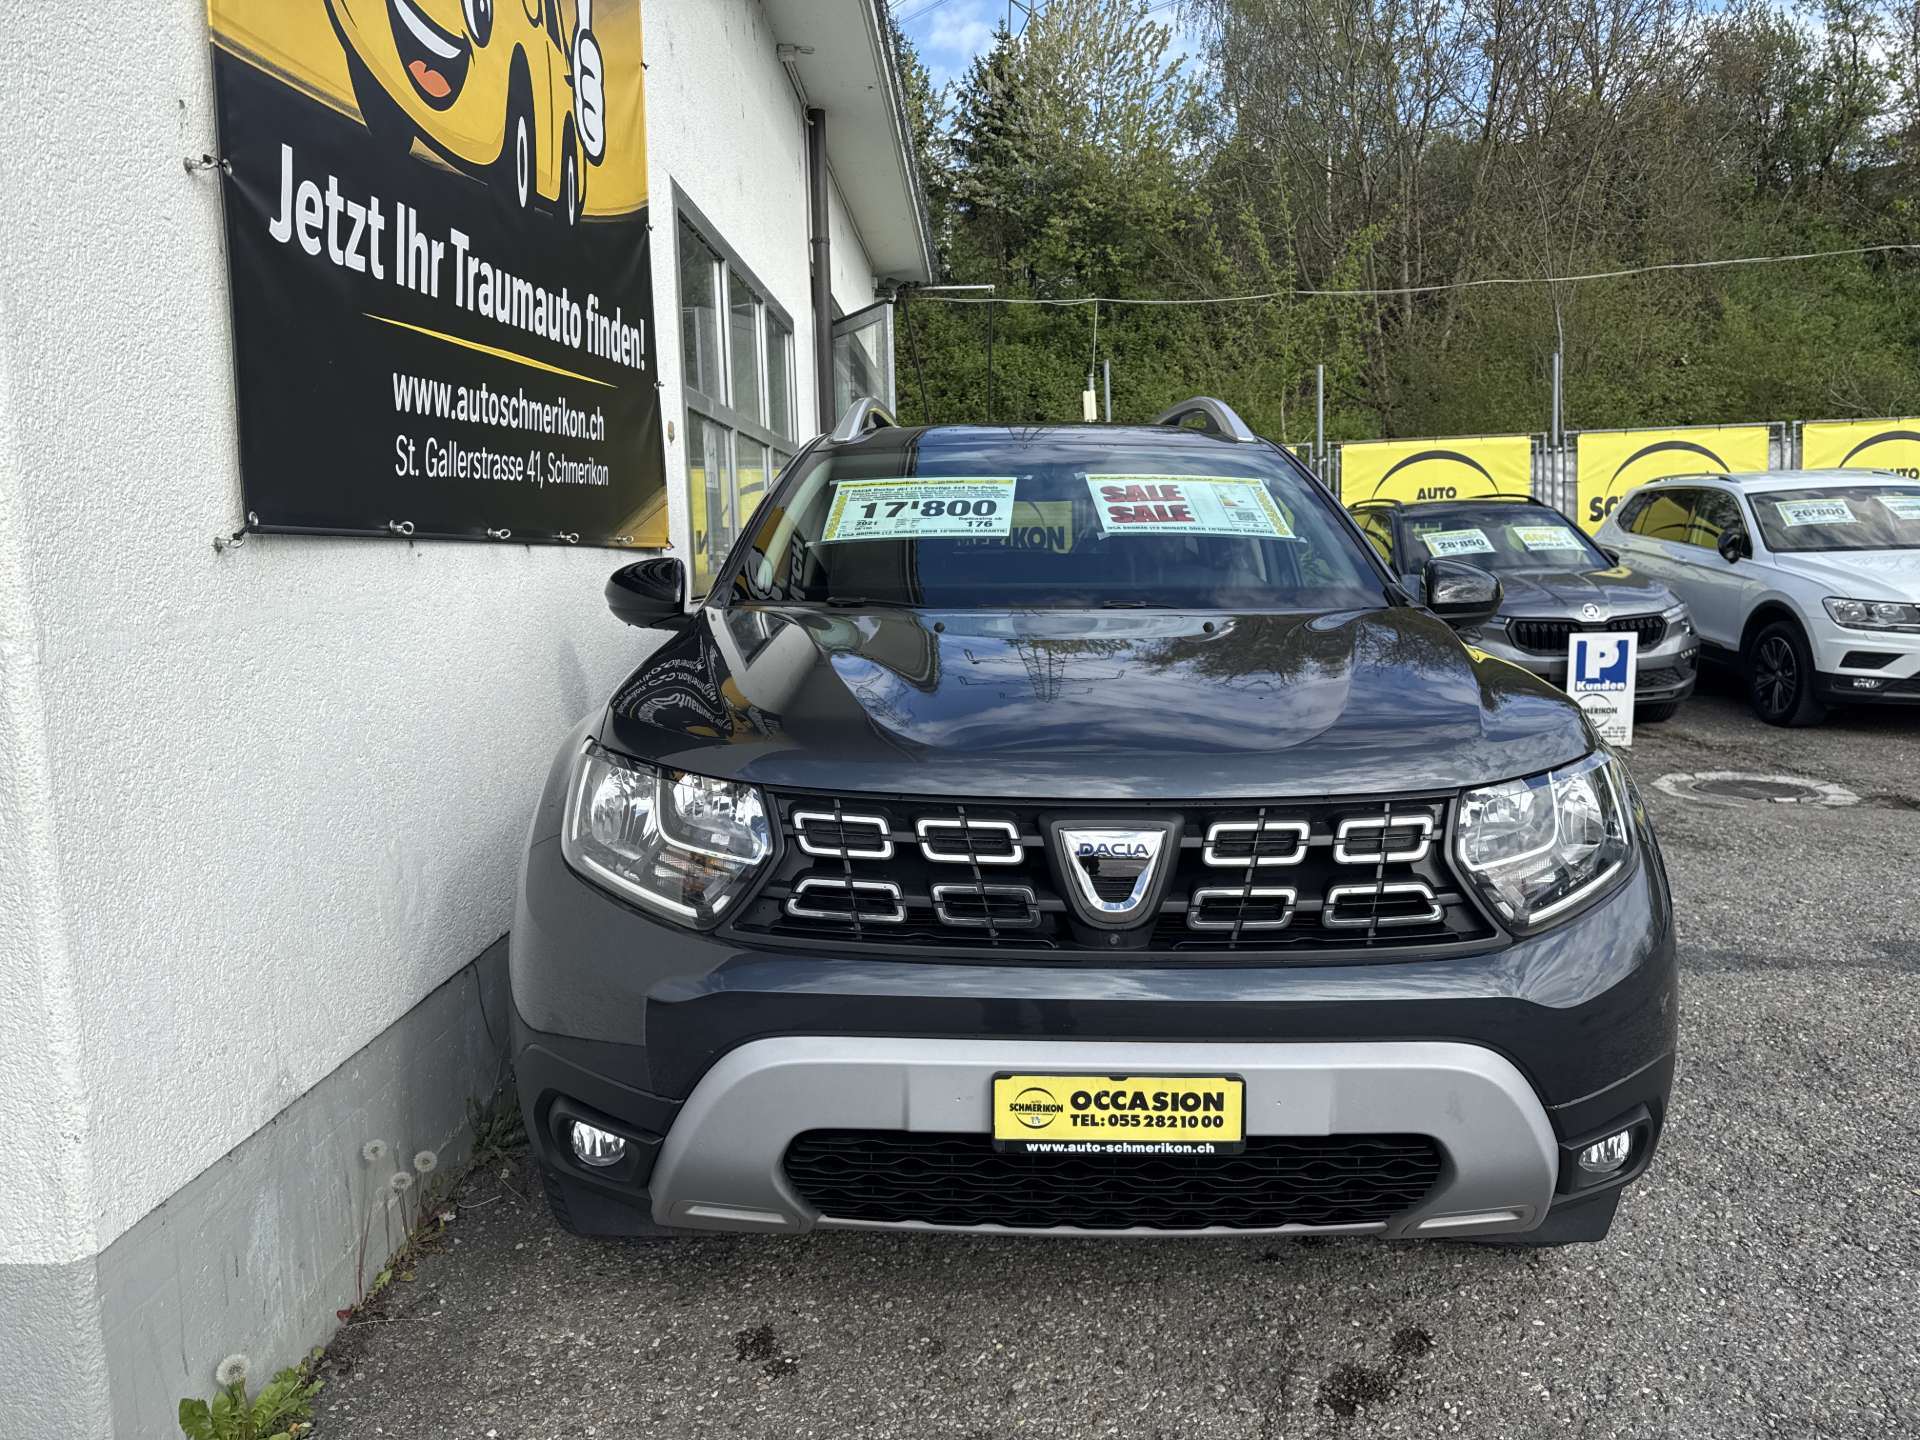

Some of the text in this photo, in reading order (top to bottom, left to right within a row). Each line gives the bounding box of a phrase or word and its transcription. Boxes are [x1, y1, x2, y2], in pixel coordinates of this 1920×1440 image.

[269, 143, 645, 370] Jetzt Ihr Traumauto finden!
[393, 372, 605, 441] www.autoschmerikon.ch
[395, 434, 609, 488] St. Gallerstrasse 41, Schmerikon
[1890, 468, 1920, 480] UTO
[1100, 485, 1185, 502] SALE
[1417, 486, 1457, 500] AUTO
[861, 499, 997, 518] 17'800
[1107, 504, 1196, 523] SALE
[967, 520, 993, 528] 176
[1585, 640, 1620, 679] P
[1576, 680, 1626, 691] Kunden
[1583, 706, 1618, 714] MERIKON
[1078, 842, 1149, 858] DACIA
[1009, 1103, 1064, 1113] SCHMERIKON
[1070, 1091, 1225, 1112] OCCASION
[1070, 1114, 1106, 1127] TEL:
[1026, 1141, 1215, 1154] www.auto-schmerikon.ch
